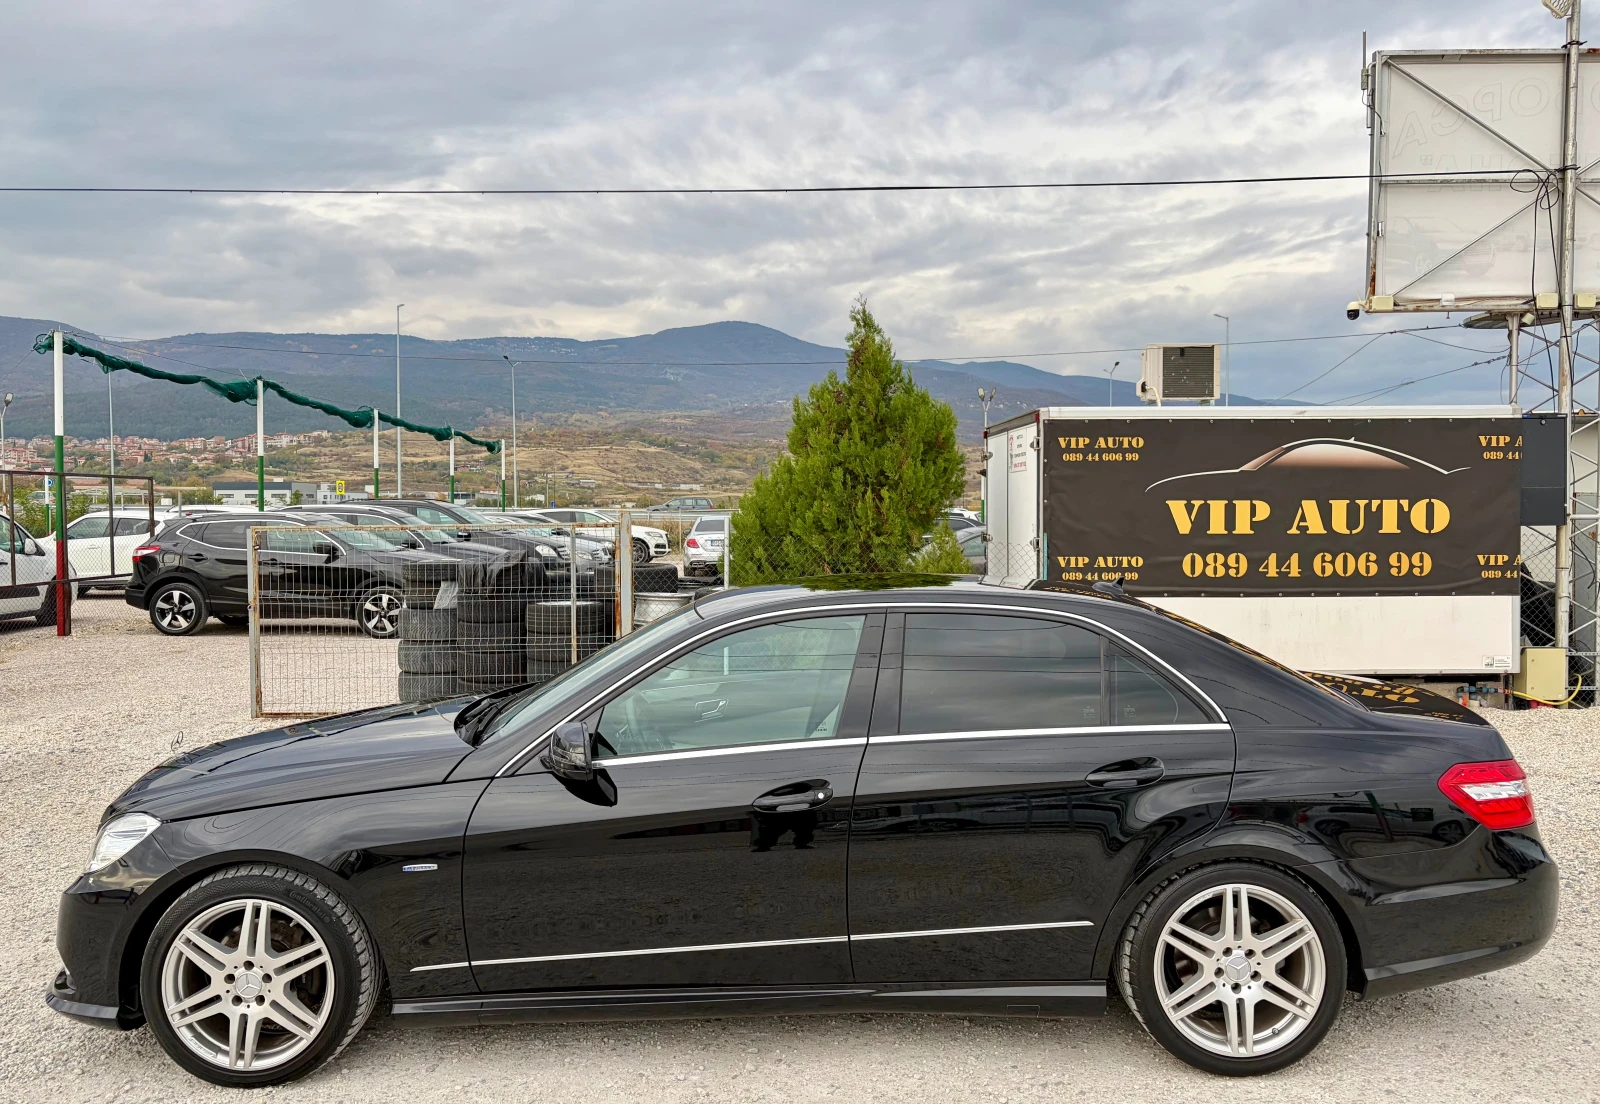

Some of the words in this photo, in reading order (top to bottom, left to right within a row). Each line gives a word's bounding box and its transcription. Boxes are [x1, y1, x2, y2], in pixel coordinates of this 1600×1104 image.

[1057, 436, 1091, 449] VIP
[1094, 436, 1145, 449] AUTO
[1478, 435, 1511, 447] VIP
[1062, 453, 1083, 462] 089
[1085, 453, 1100, 462] 44
[1102, 453, 1123, 462] 606
[1125, 453, 1140, 462] 99
[1482, 451, 1504, 460] 089
[1505, 451, 1520, 460] 44
[1165, 499, 1271, 535] VIP
[1286, 498, 1451, 535] AUTO
[1057, 556, 1090, 568] VIP
[1093, 555, 1144, 568] AUTO
[1181, 552, 1249, 578] 089
[1258, 552, 1302, 578] 44
[1312, 551, 1379, 578] 606
[1388, 551, 1433, 577] 99
[1476, 554, 1509, 566] VIP
[1061, 571, 1083, 581] 089
[1085, 571, 1099, 581] 44
[1124, 571, 1139, 581] 99
[1480, 569, 1502, 579] 089
[1503, 569, 1518, 579] 44
